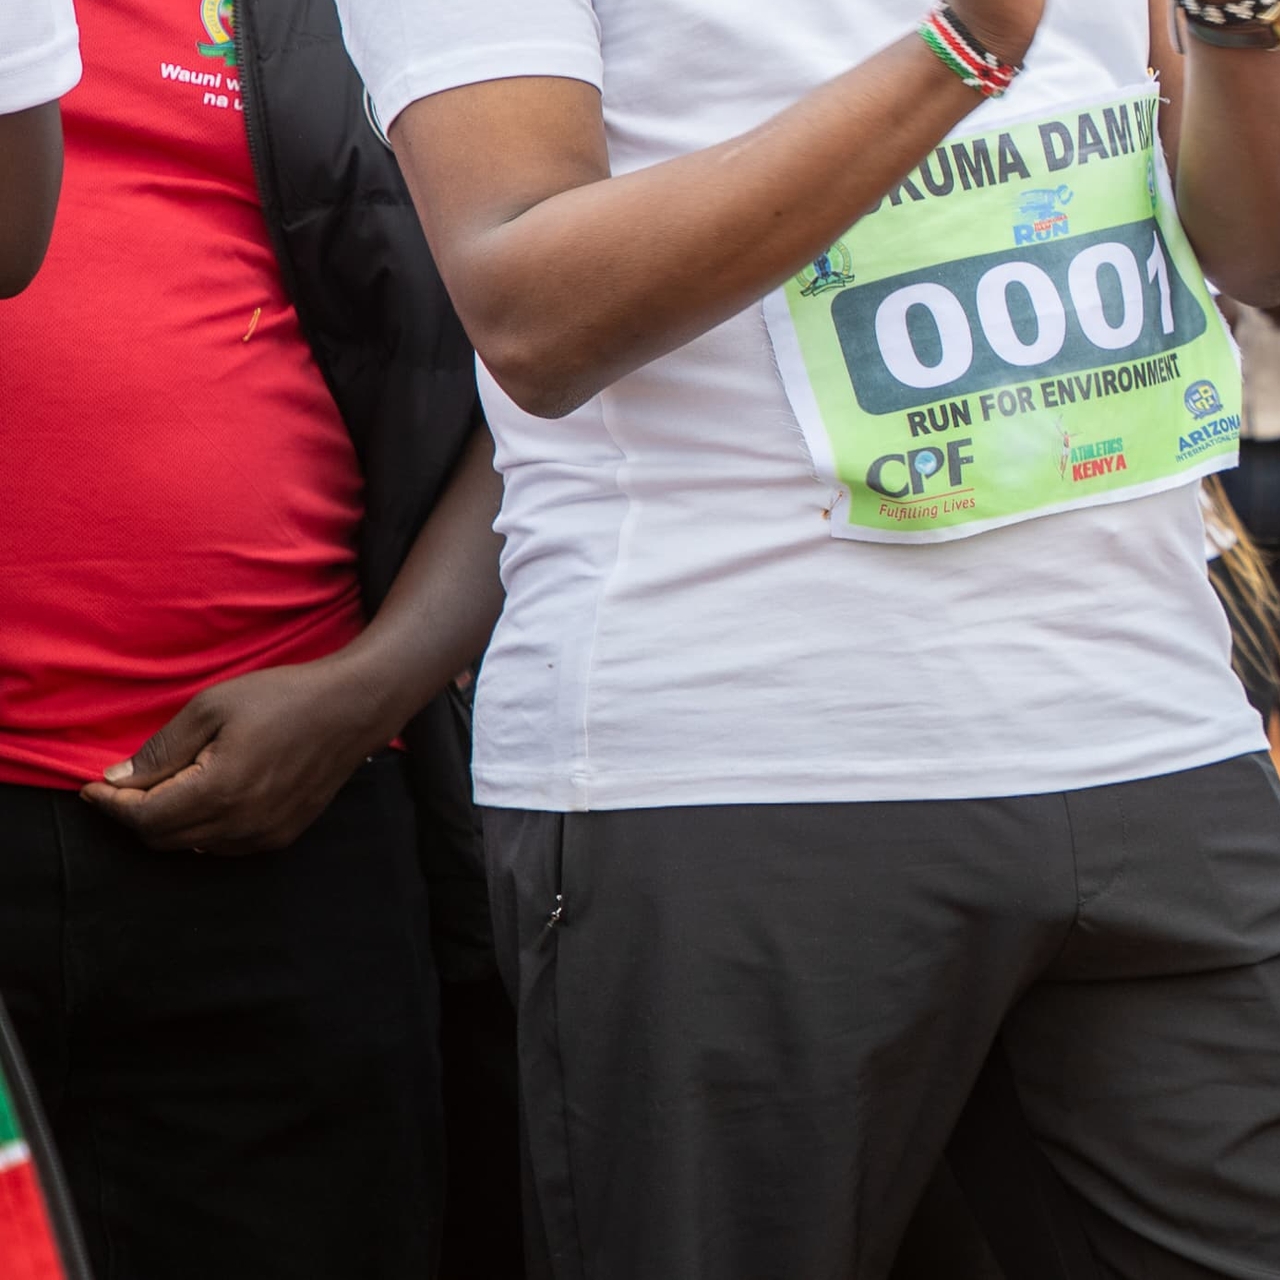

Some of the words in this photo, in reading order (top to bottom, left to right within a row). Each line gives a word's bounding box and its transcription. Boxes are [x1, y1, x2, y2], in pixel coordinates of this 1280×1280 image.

[160, 62, 221, 88] Wauni
[203, 92, 229, 108] na
[860, 133, 1031, 214] KUMA
[1038, 104, 1135, 172] DAM
[875, 230, 1174, 389] 0001
[907, 400, 972, 437] RUN
[979, 385, 1036, 422] FOR
[1040, 352, 1181, 408] ENVIRONMENT
[1071, 438, 1124, 463] ATHLETICS
[1175, 433, 1231, 462] INTERNATIONAL
[866, 438, 974, 498] CPF
[1072, 454, 1127, 482] KENYA
[879, 503, 938, 521] Fulfilling
[944, 498, 976, 514] Lives
